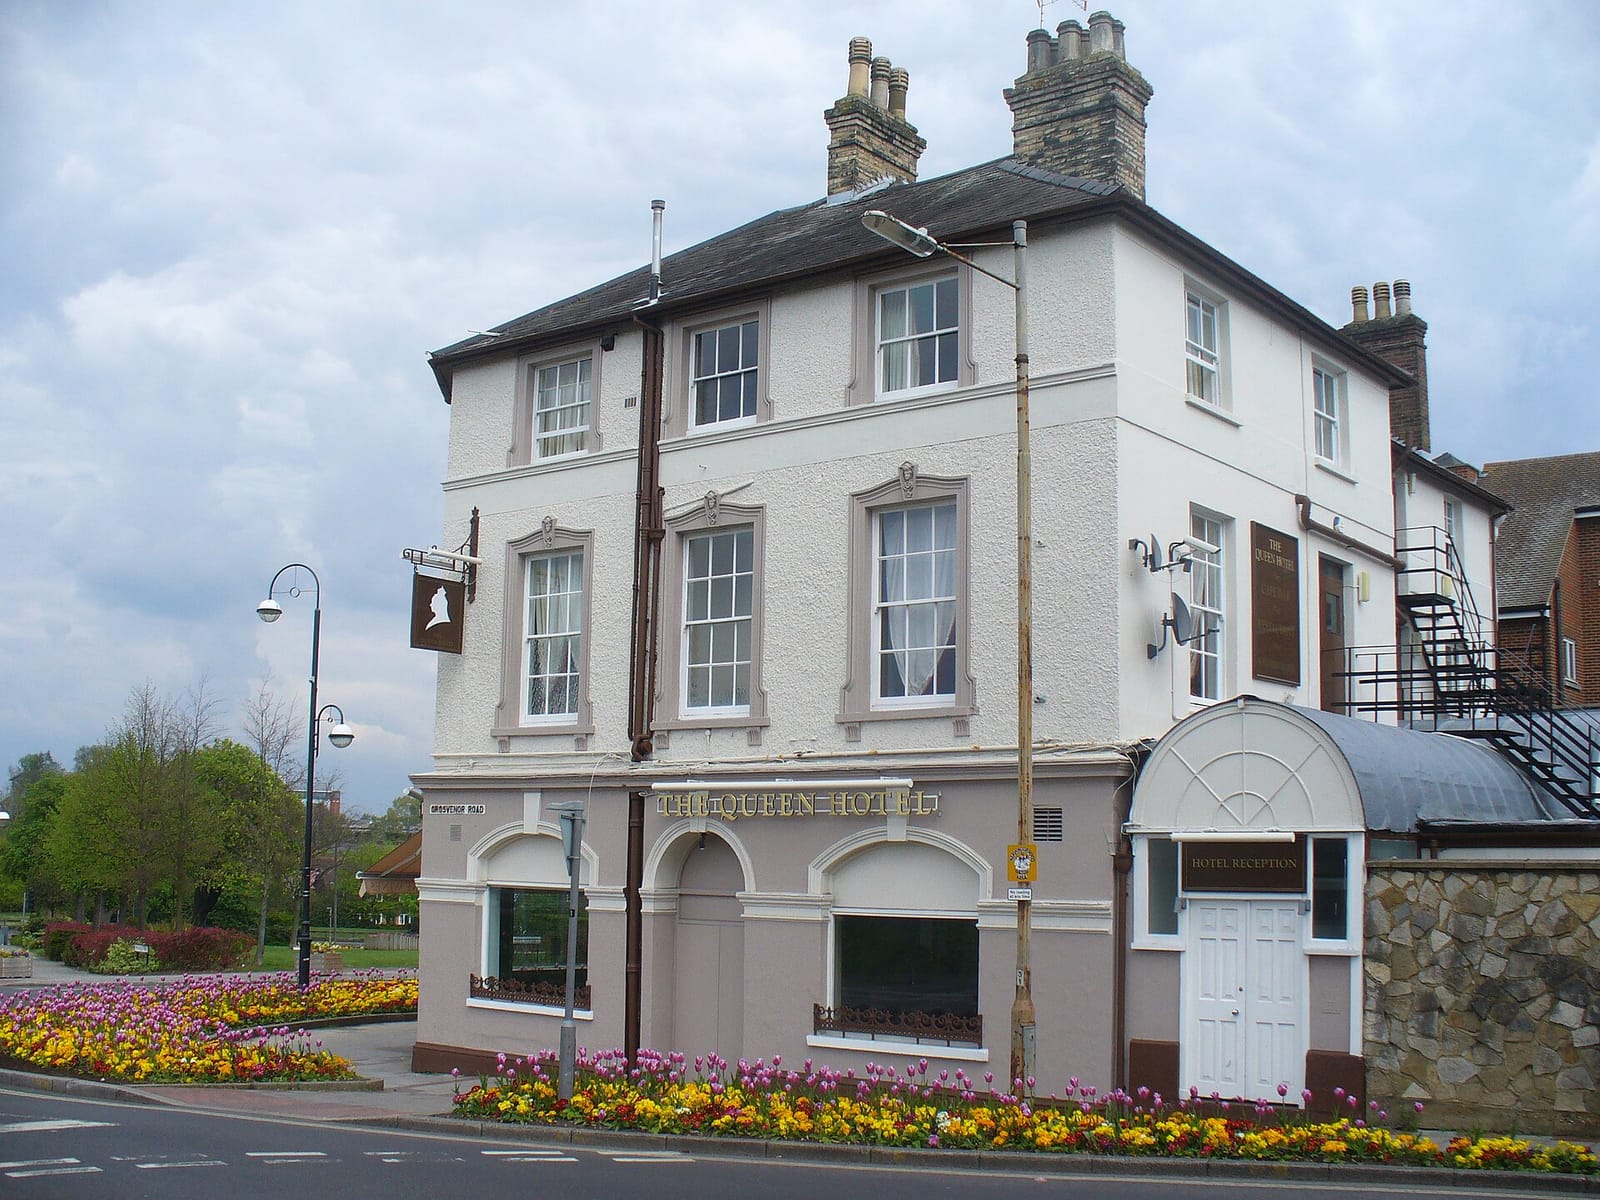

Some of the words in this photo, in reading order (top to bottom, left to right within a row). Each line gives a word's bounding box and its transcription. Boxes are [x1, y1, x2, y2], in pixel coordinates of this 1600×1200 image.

[1269, 538, 1282, 553] THE
[1255, 547, 1276, 565] QUEEN
[1276, 554, 1295, 572] HOTEL
[431, 805, 466, 814] GROSVENOR
[467, 805, 484, 814] ROAD
[658, 792, 711, 818] THE
[720, 792, 817, 821] QUEEN
[830, 790, 932, 817] HOTEL
[1192, 858, 1230, 869] HOTEL
[1232, 858, 1297, 869] RECEPTION
